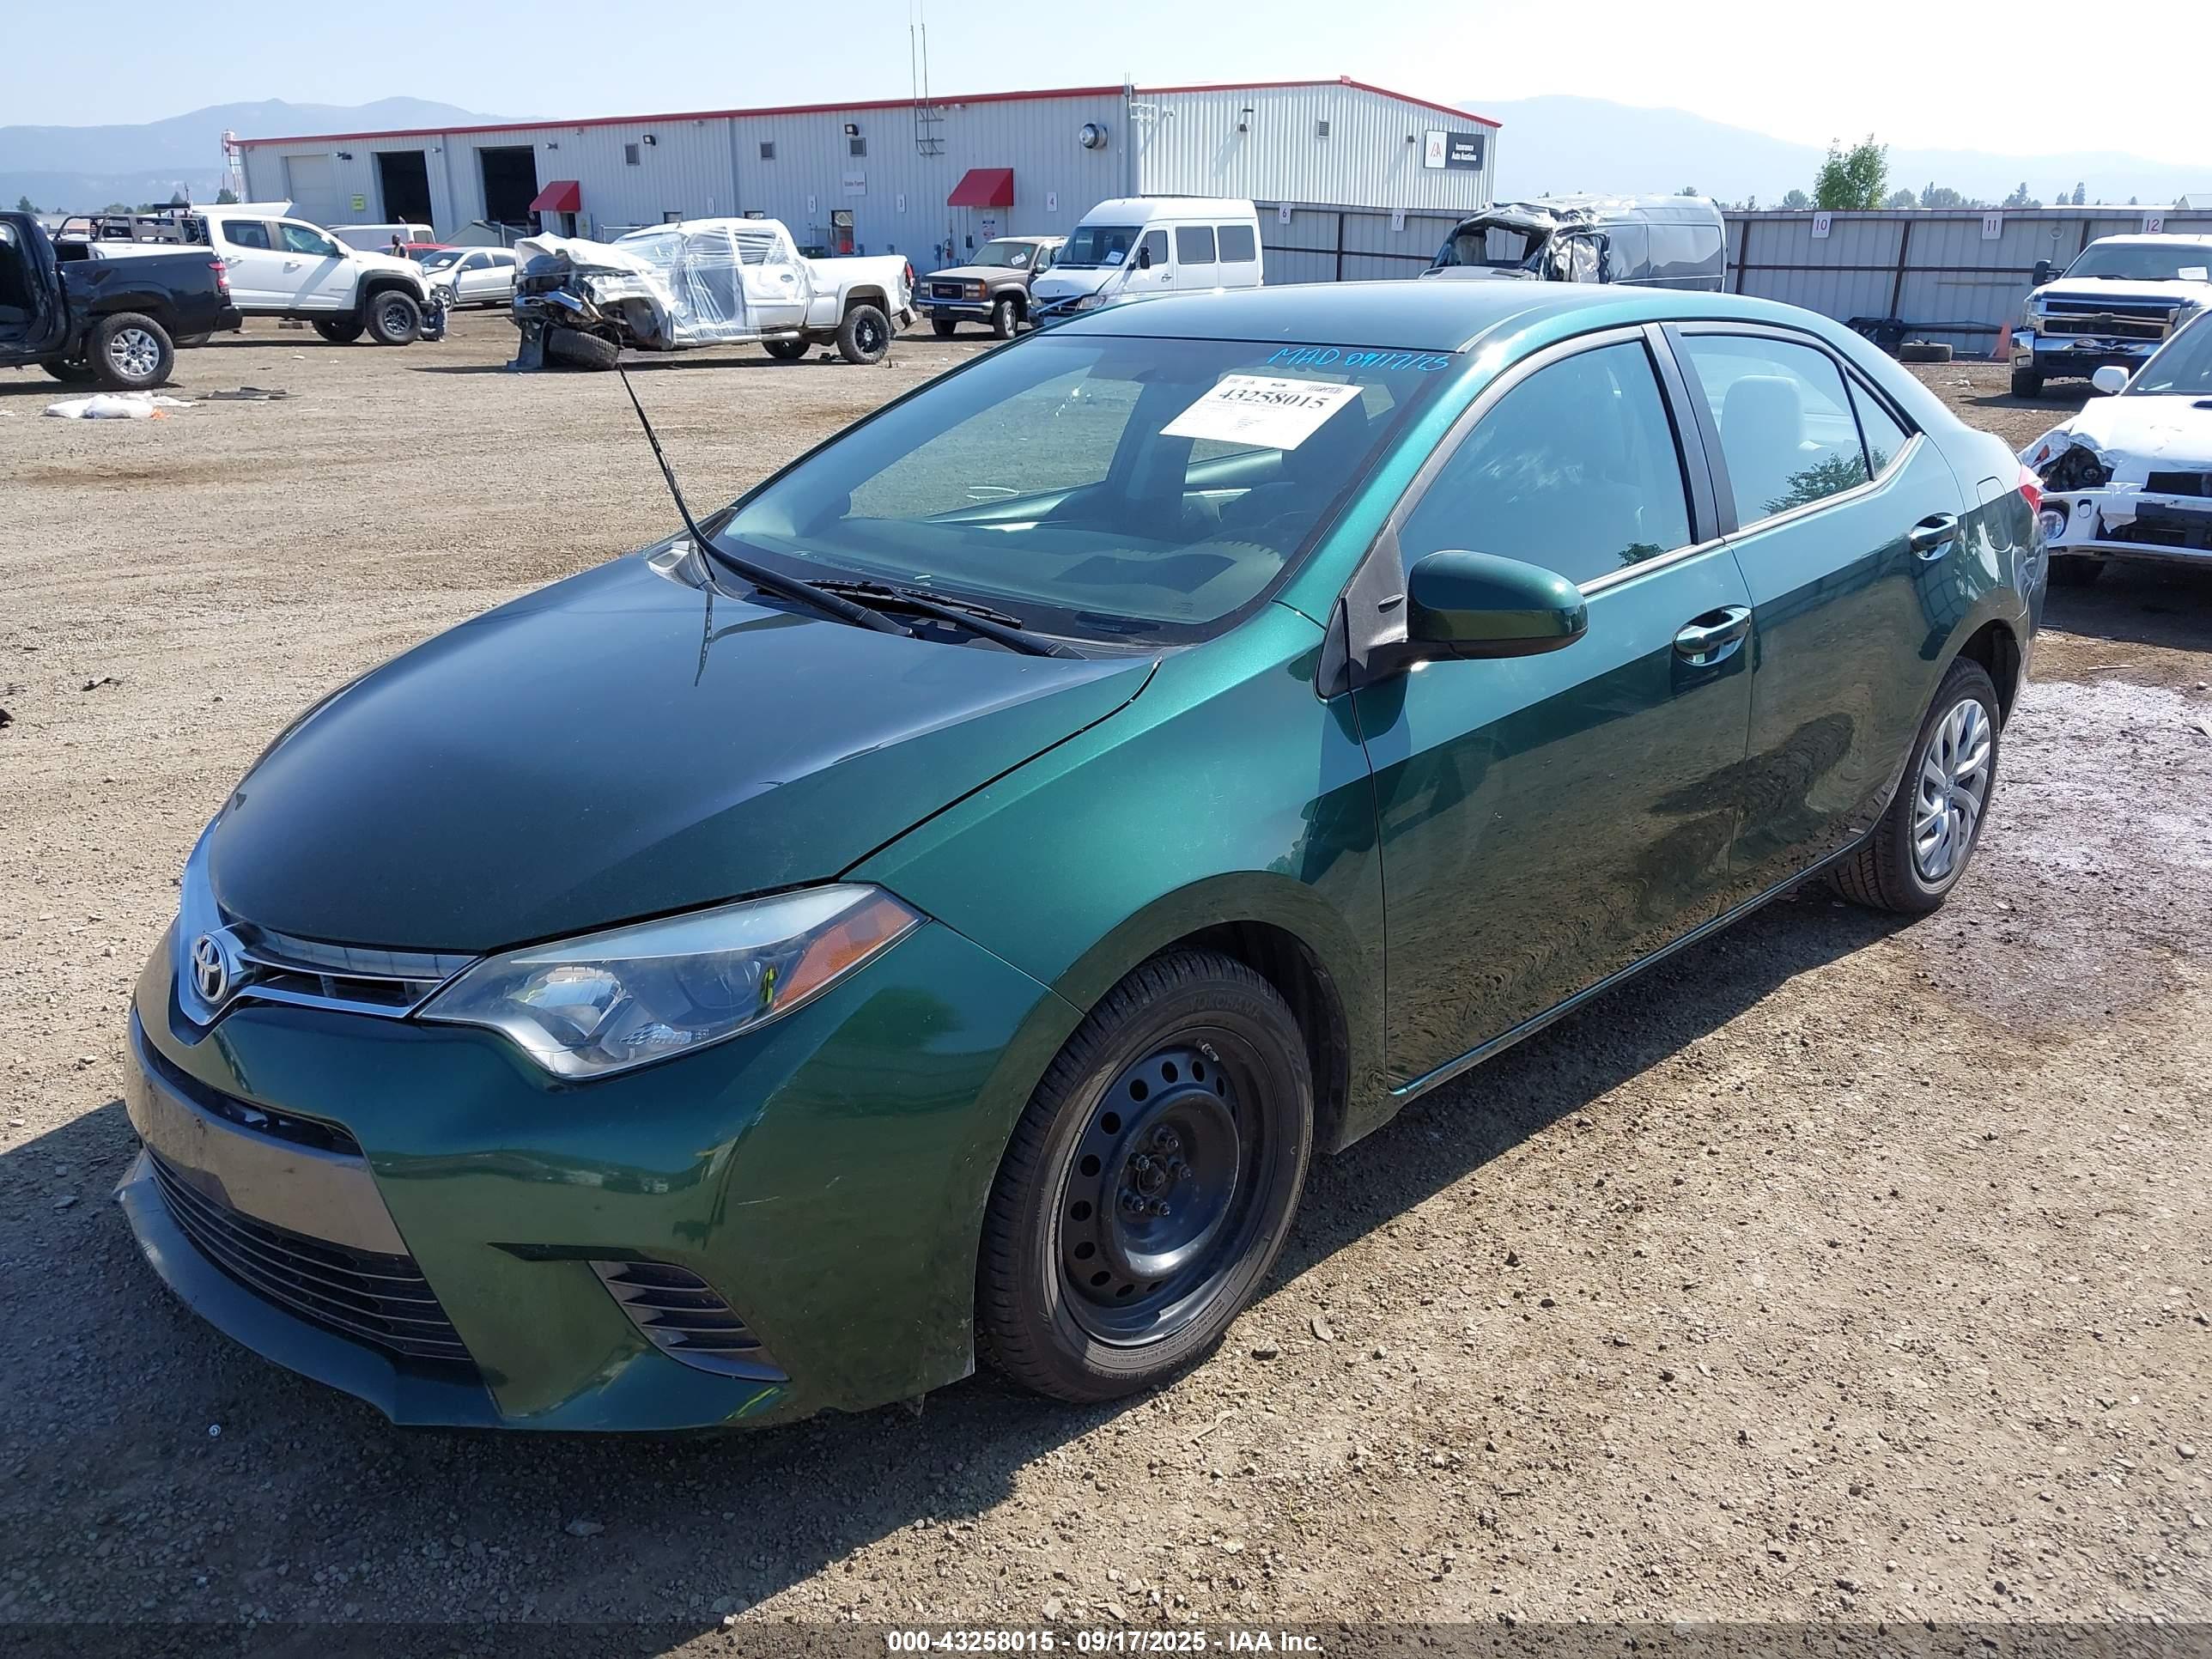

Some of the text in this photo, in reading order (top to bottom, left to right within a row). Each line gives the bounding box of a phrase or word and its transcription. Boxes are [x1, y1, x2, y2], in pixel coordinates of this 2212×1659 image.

[1282, 208, 1287, 218] 6
[1395, 215, 1401, 224] 7
[1816, 219, 1828, 231] 10
[1987, 219, 1996, 232] 11
[2146, 219, 2160, 232] 12
[1267, 348, 1340, 365] MAD
[1218, 388, 1330, 410] 43258015
